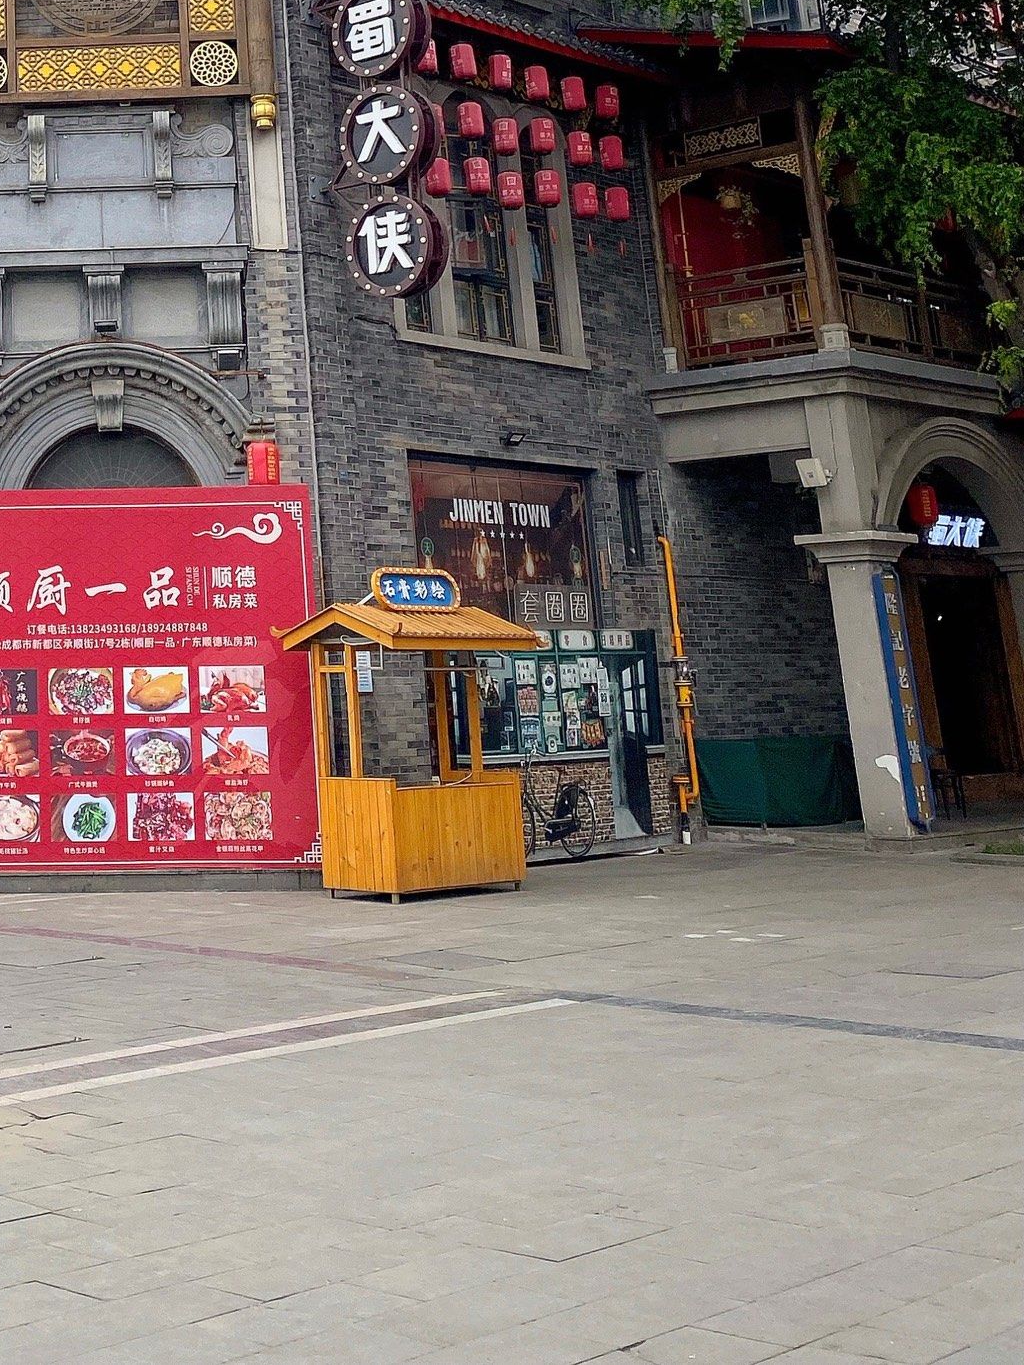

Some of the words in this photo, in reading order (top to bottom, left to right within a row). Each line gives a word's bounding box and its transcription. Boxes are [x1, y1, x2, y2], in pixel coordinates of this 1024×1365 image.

[449, 498, 504, 525] JINMEN
[509, 502, 551, 528] TOWN
[211, 566, 257, 588] 顺德
[383, 578, 446, 601] 石膏彩绘
[212, 593, 258, 610] 私房菜
[519, 590, 589, 624] 套圈圈
